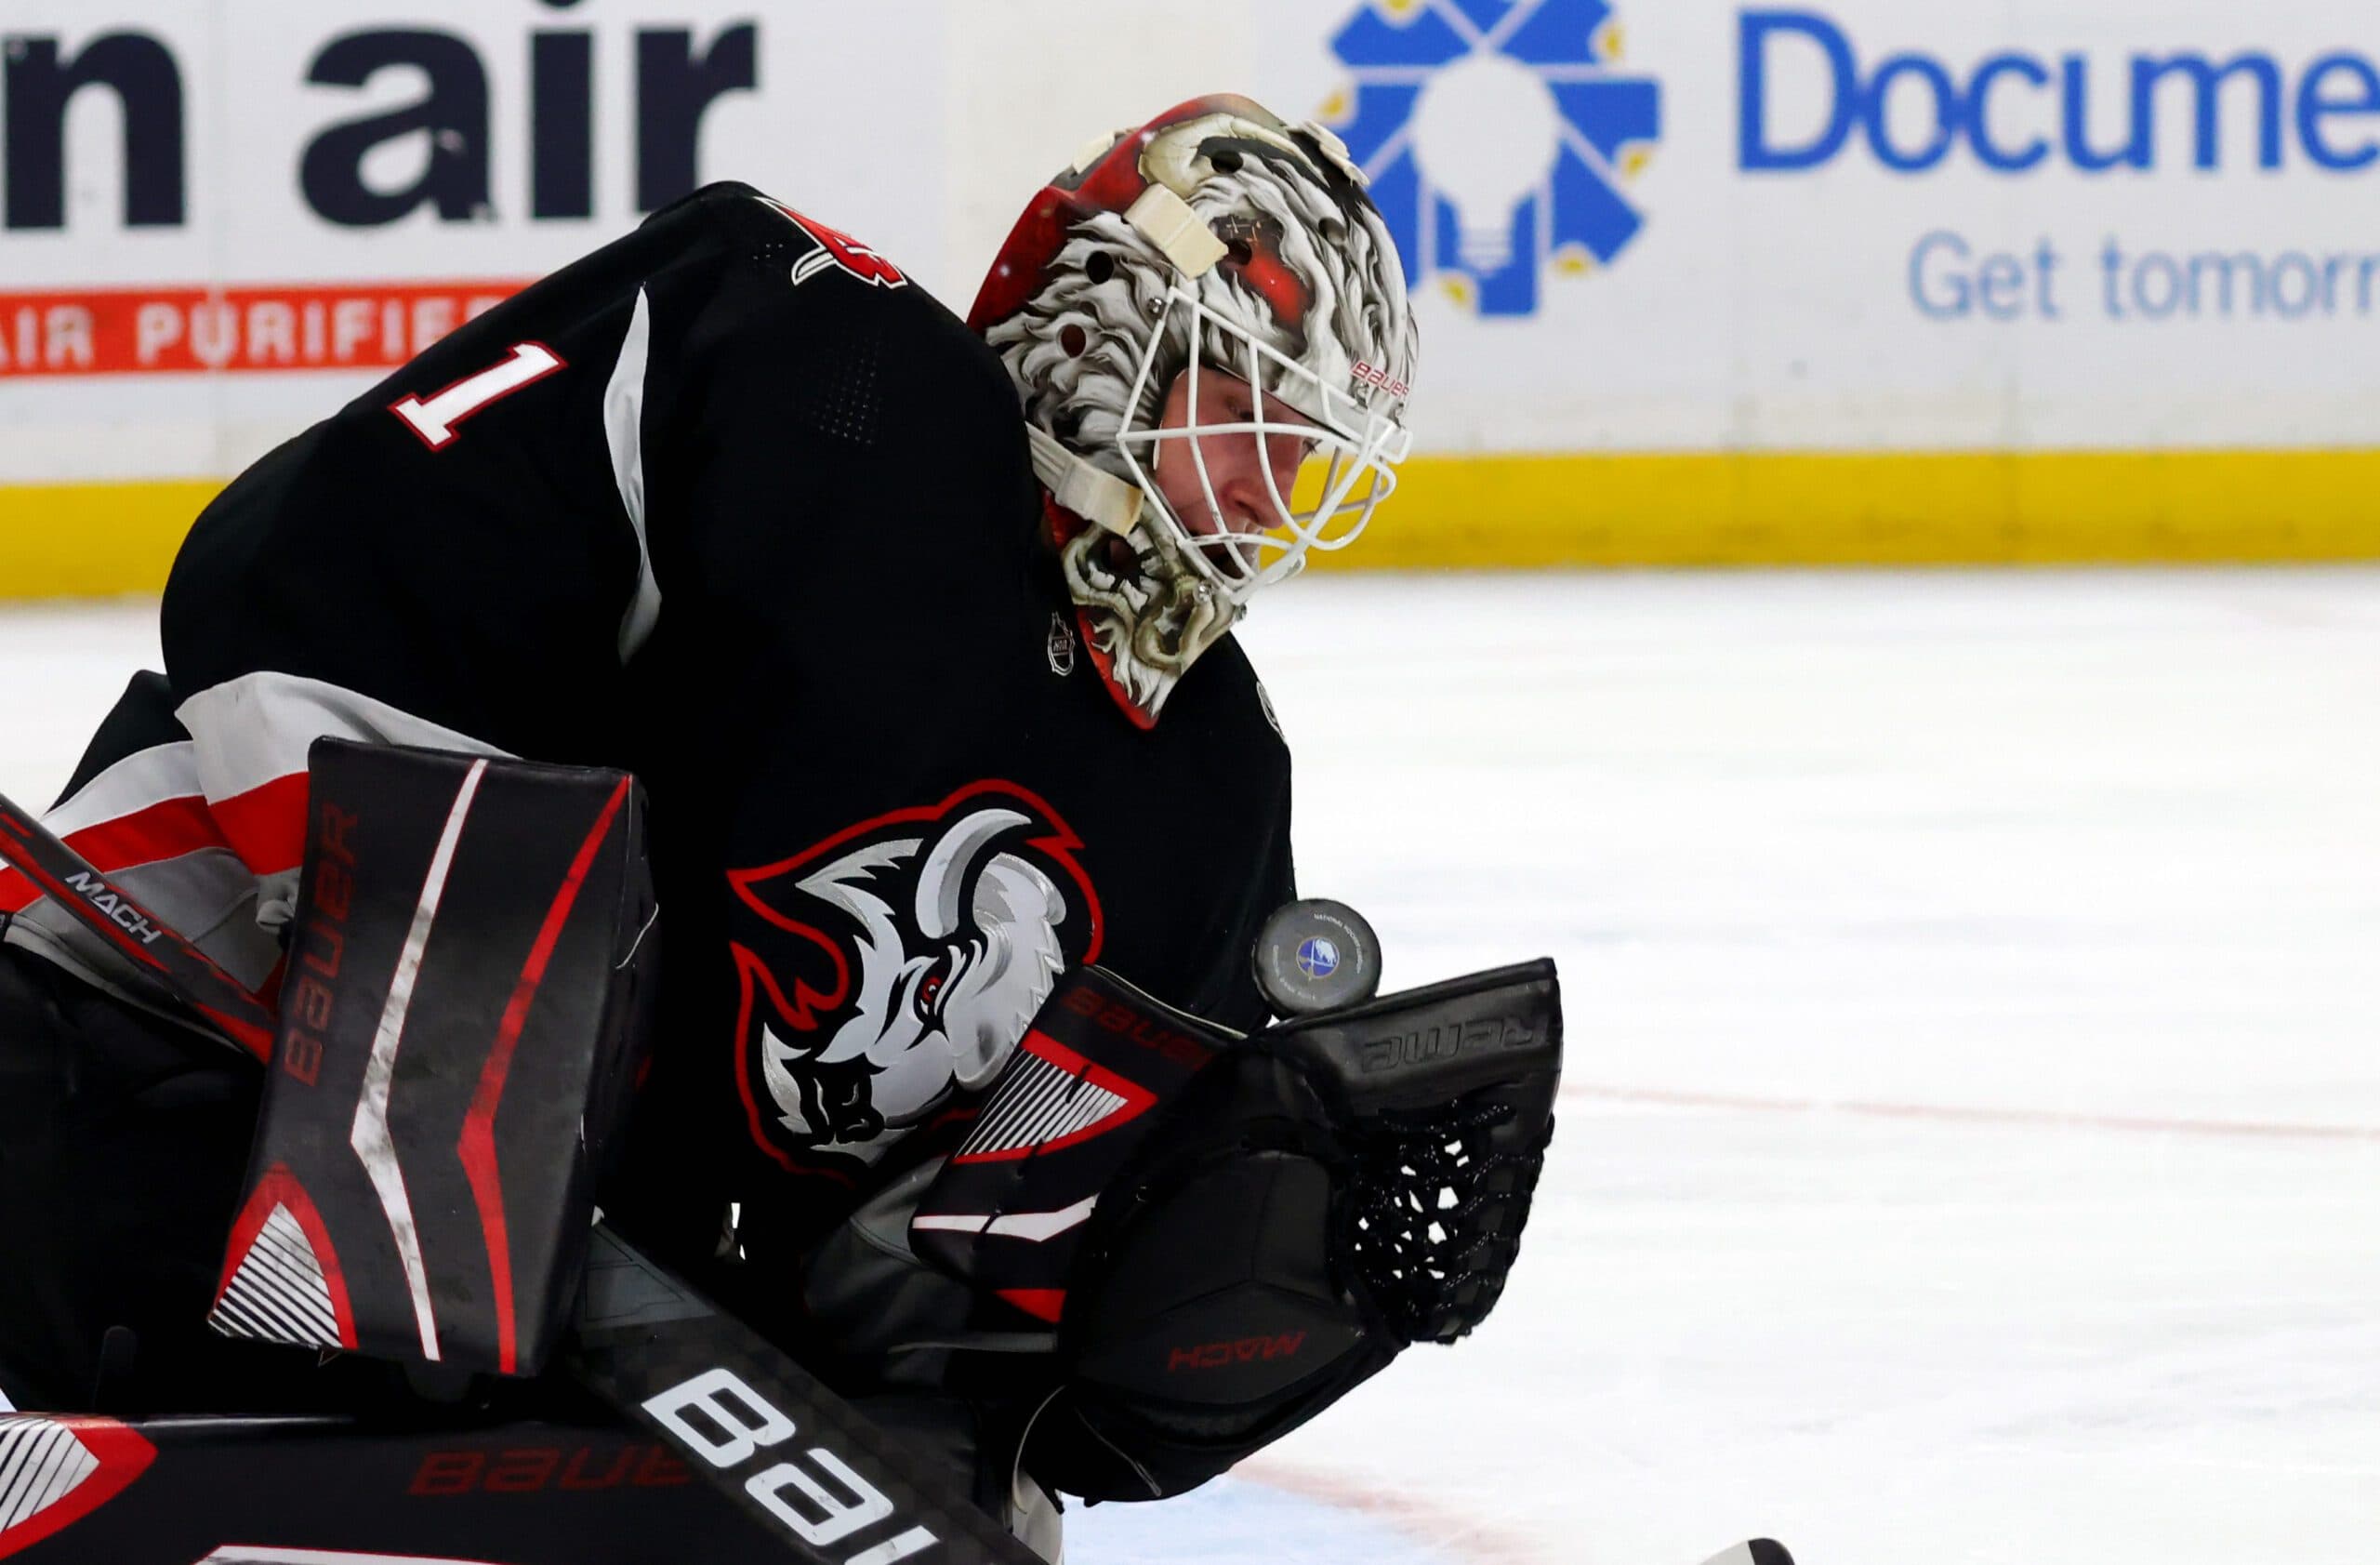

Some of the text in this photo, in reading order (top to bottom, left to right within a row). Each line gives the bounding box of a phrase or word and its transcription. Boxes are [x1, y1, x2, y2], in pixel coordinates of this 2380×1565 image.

[298, 0, 758, 228] air
[1907, 230, 2059, 321] Get
[0, 294, 508, 367] IR PURIFIE
[389, 340, 568, 453] 1
[65, 871, 162, 945] MACH
[1168, 1331, 1306, 1372] MACH
